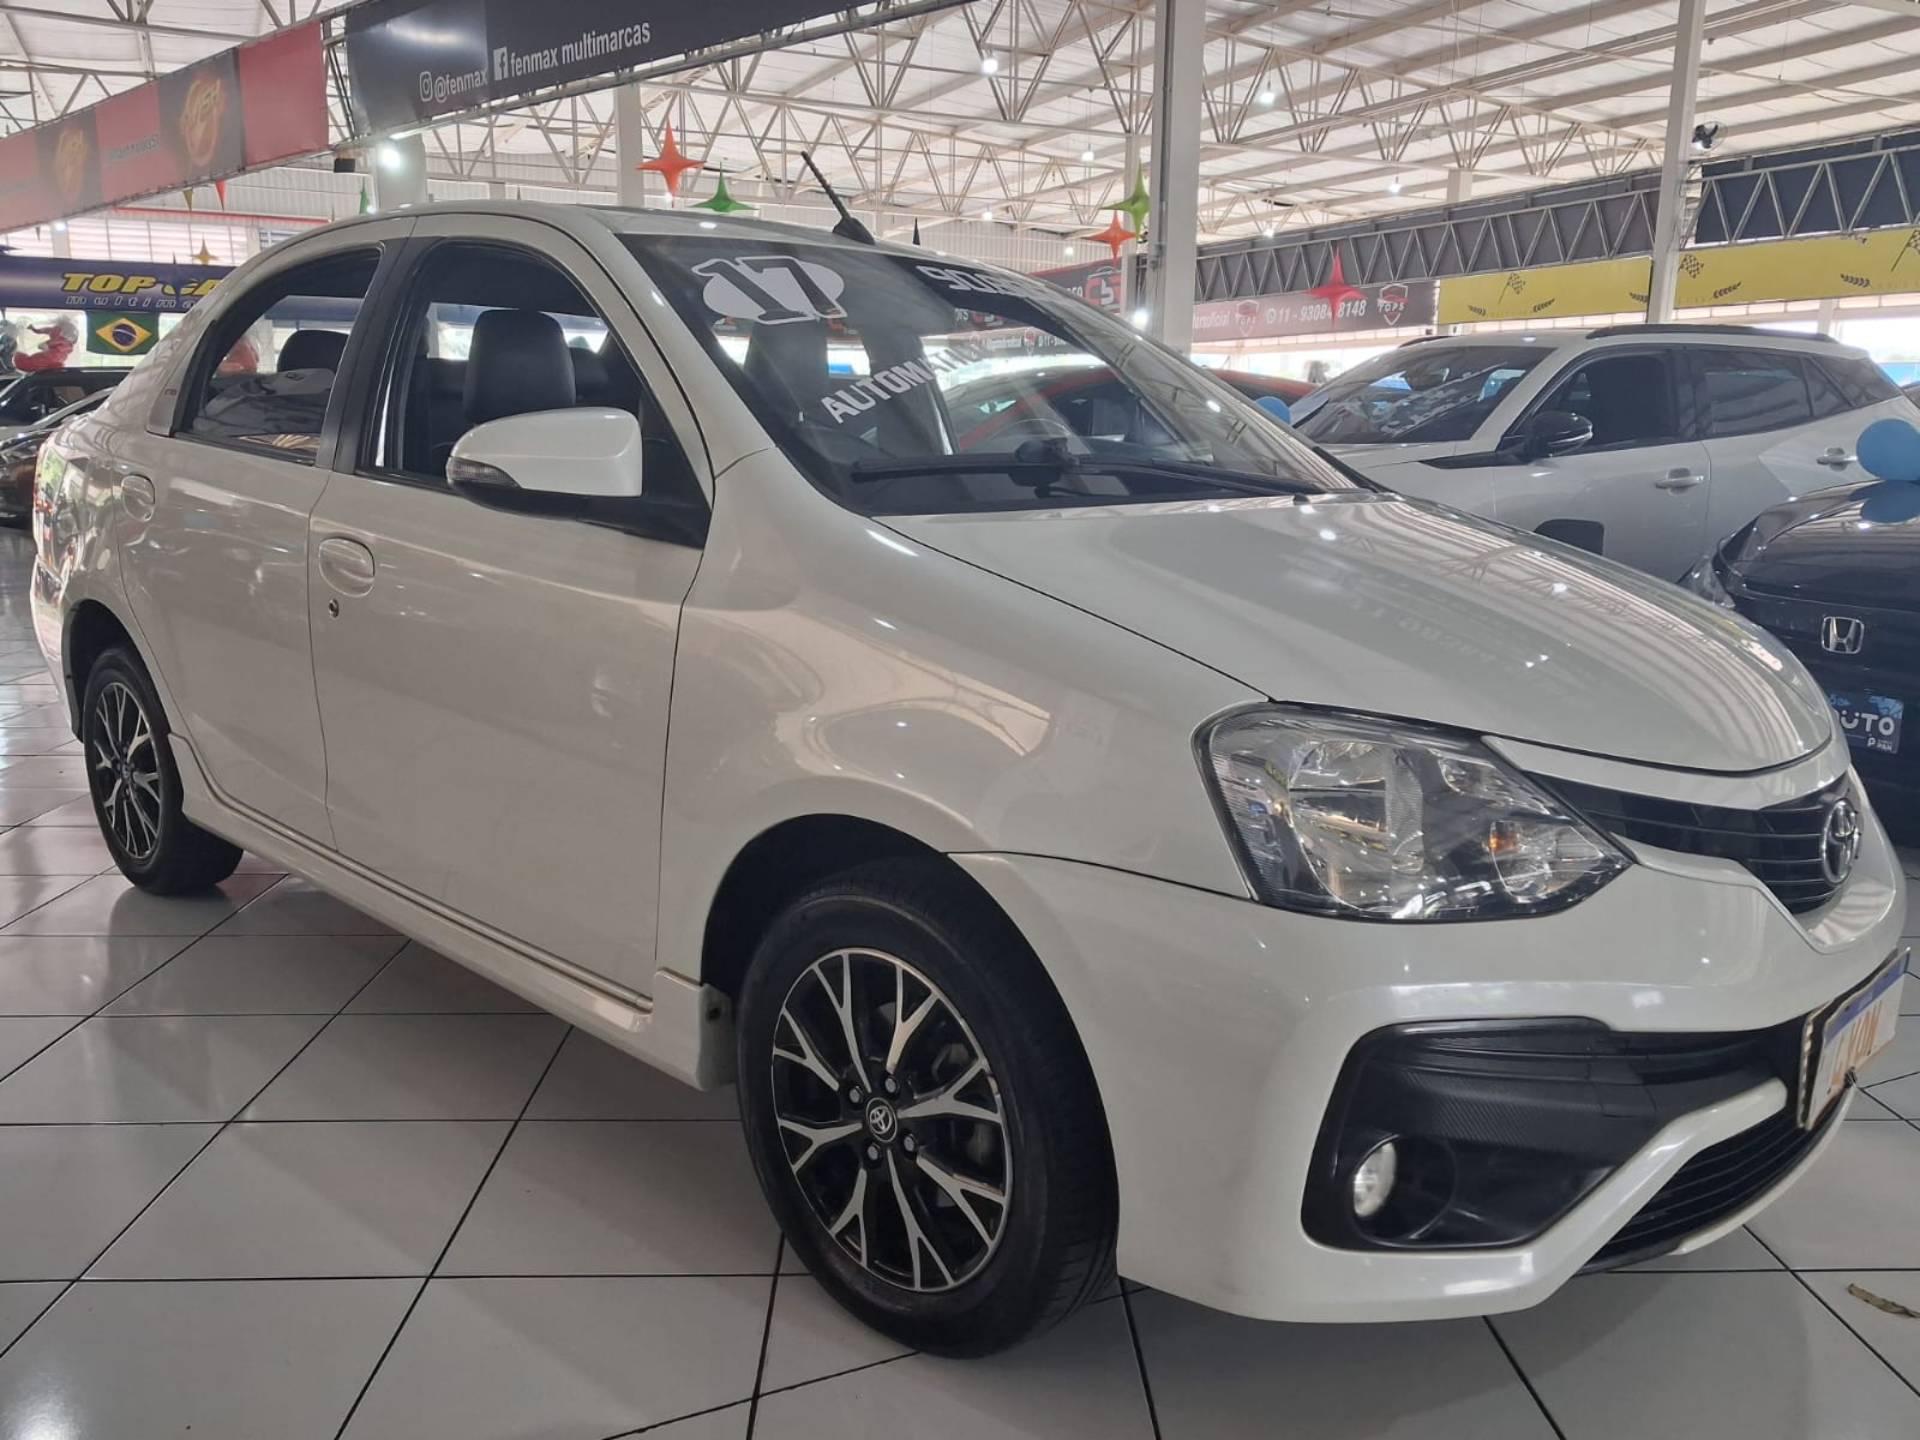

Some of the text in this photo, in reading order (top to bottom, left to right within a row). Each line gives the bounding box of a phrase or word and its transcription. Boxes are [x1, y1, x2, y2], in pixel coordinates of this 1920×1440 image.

[510, 47, 558, 77] fenmax
[561, 22, 651, 64] multimarcas
[434, 69, 488, 103] @fenmax
[62, 272, 156, 294] TOP
[691, 256, 847, 324] 17
[65, 295, 196, 309] multima
[1377, 300, 1406, 314] TOPS
